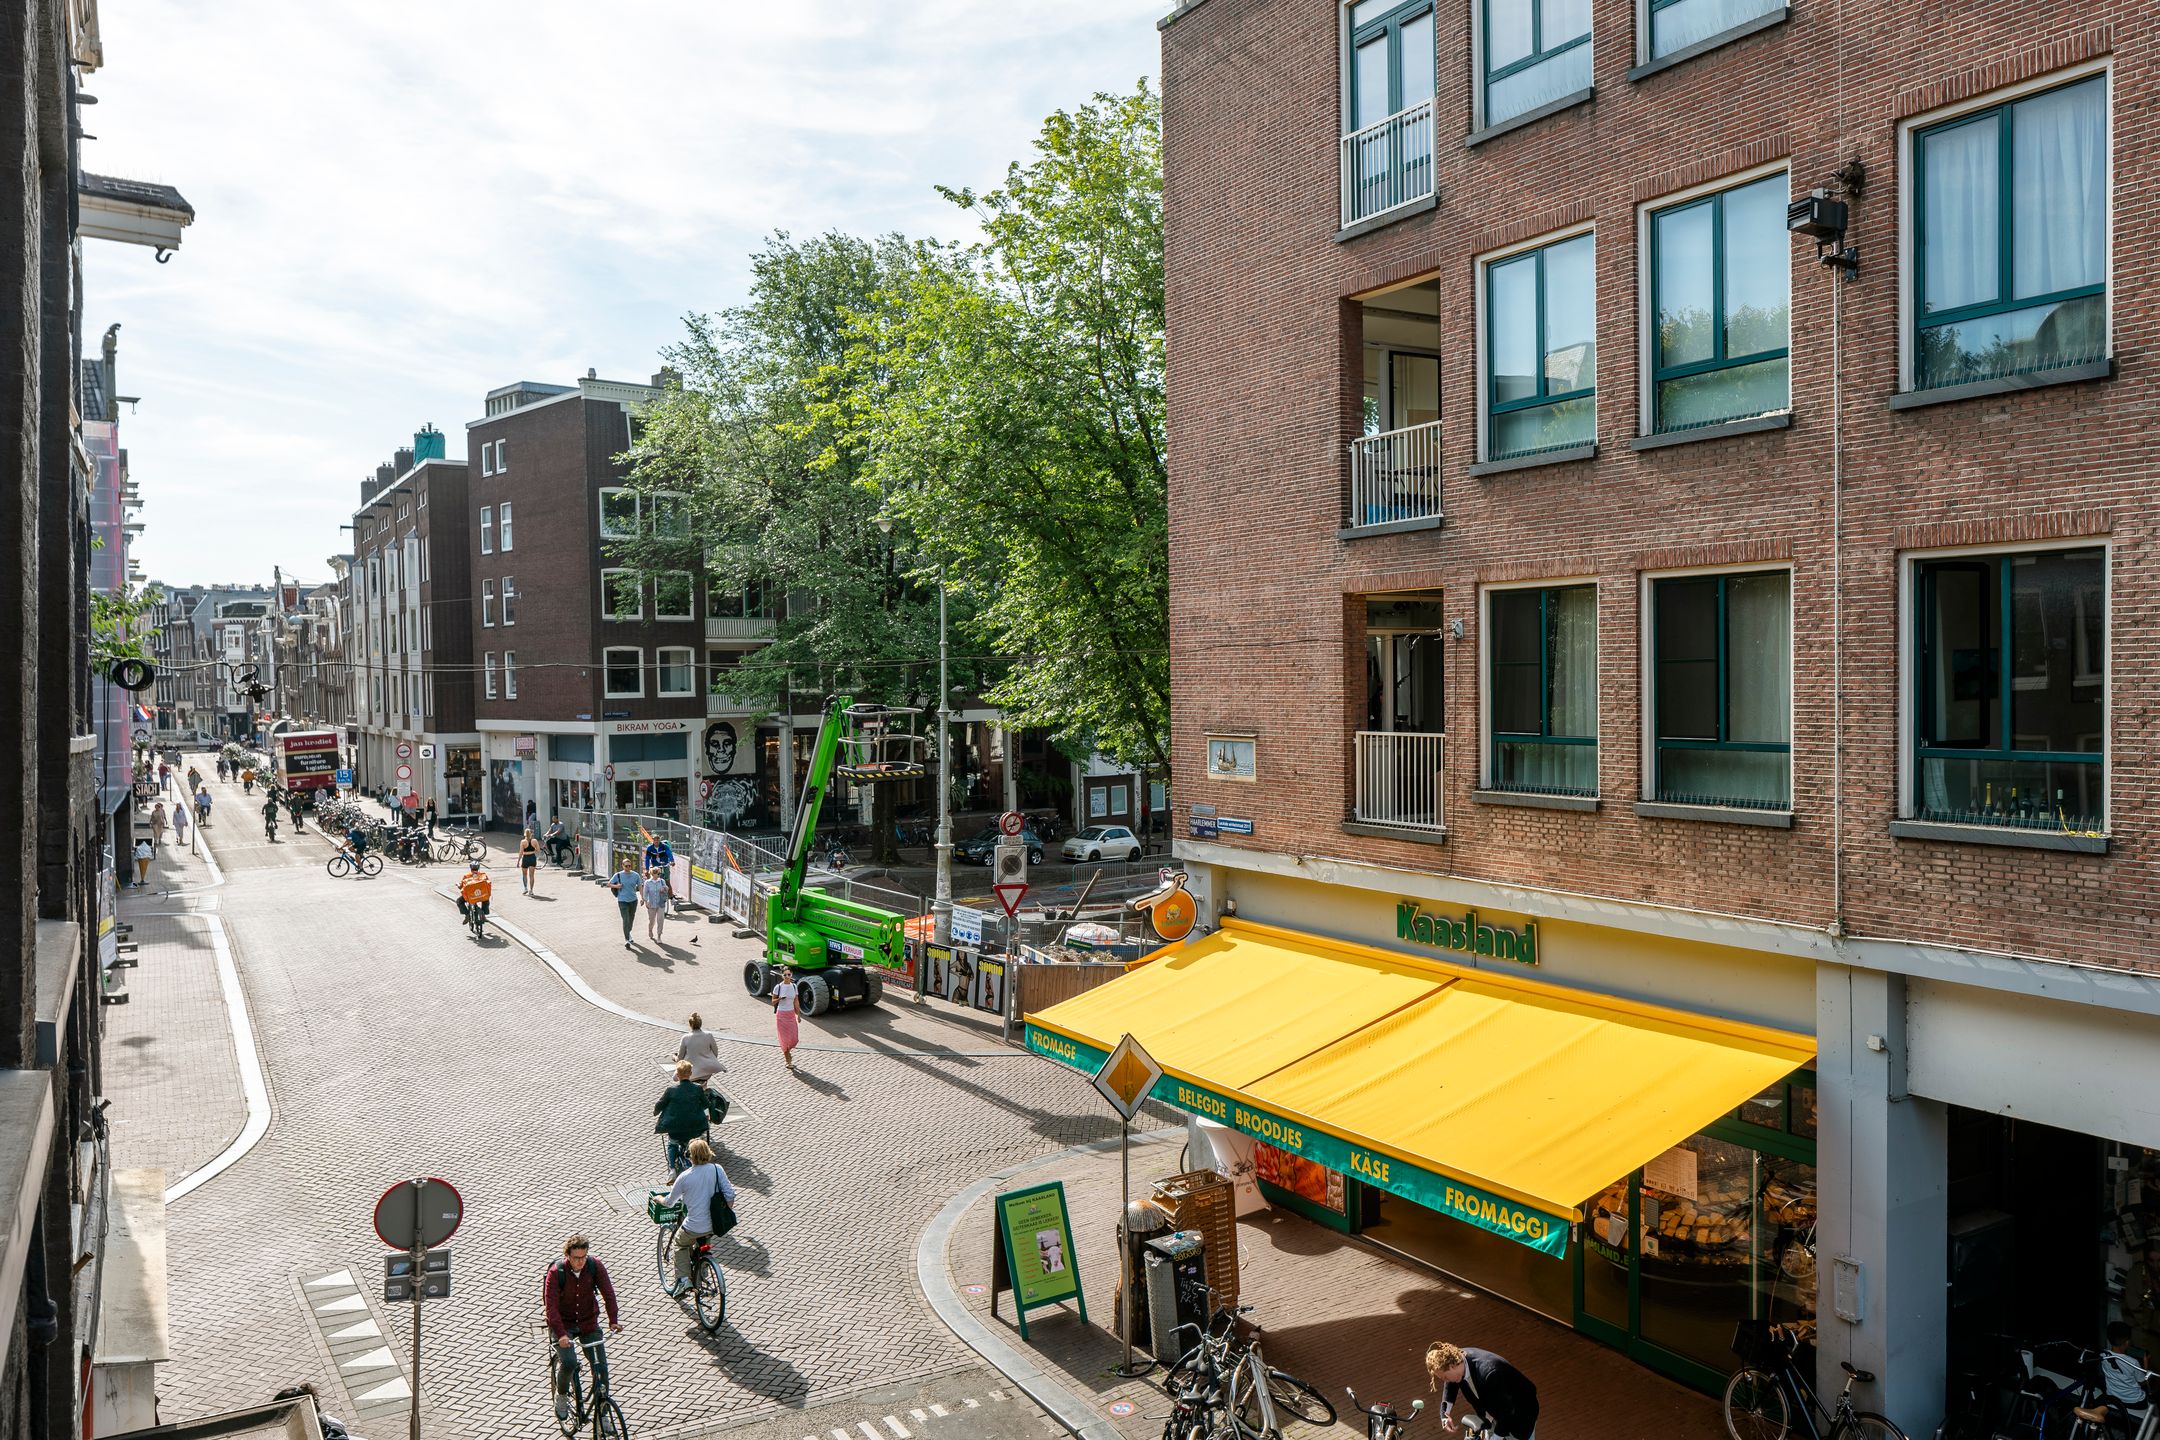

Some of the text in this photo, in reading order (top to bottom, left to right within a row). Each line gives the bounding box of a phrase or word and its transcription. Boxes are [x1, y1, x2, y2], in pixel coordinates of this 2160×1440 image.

[617, 722, 677, 732] BIKRAM YOGA
[135, 783, 157, 795] STACH
[1190, 819, 1216, 828] HAARLEMMER
[1397, 903, 1538, 965] Kaasland
[829, 940, 862, 957] HWS VERHUUR
[1032, 1031, 1077, 1060] FROMAGE
[1178, 1086, 1302, 1149] BELEGDE BROODJES
[1351, 1151, 1390, 1182] KÄSE
[1032, 1193, 1056, 1202] KAASLAND
[1445, 1186, 1549, 1242] FROMAGGI
